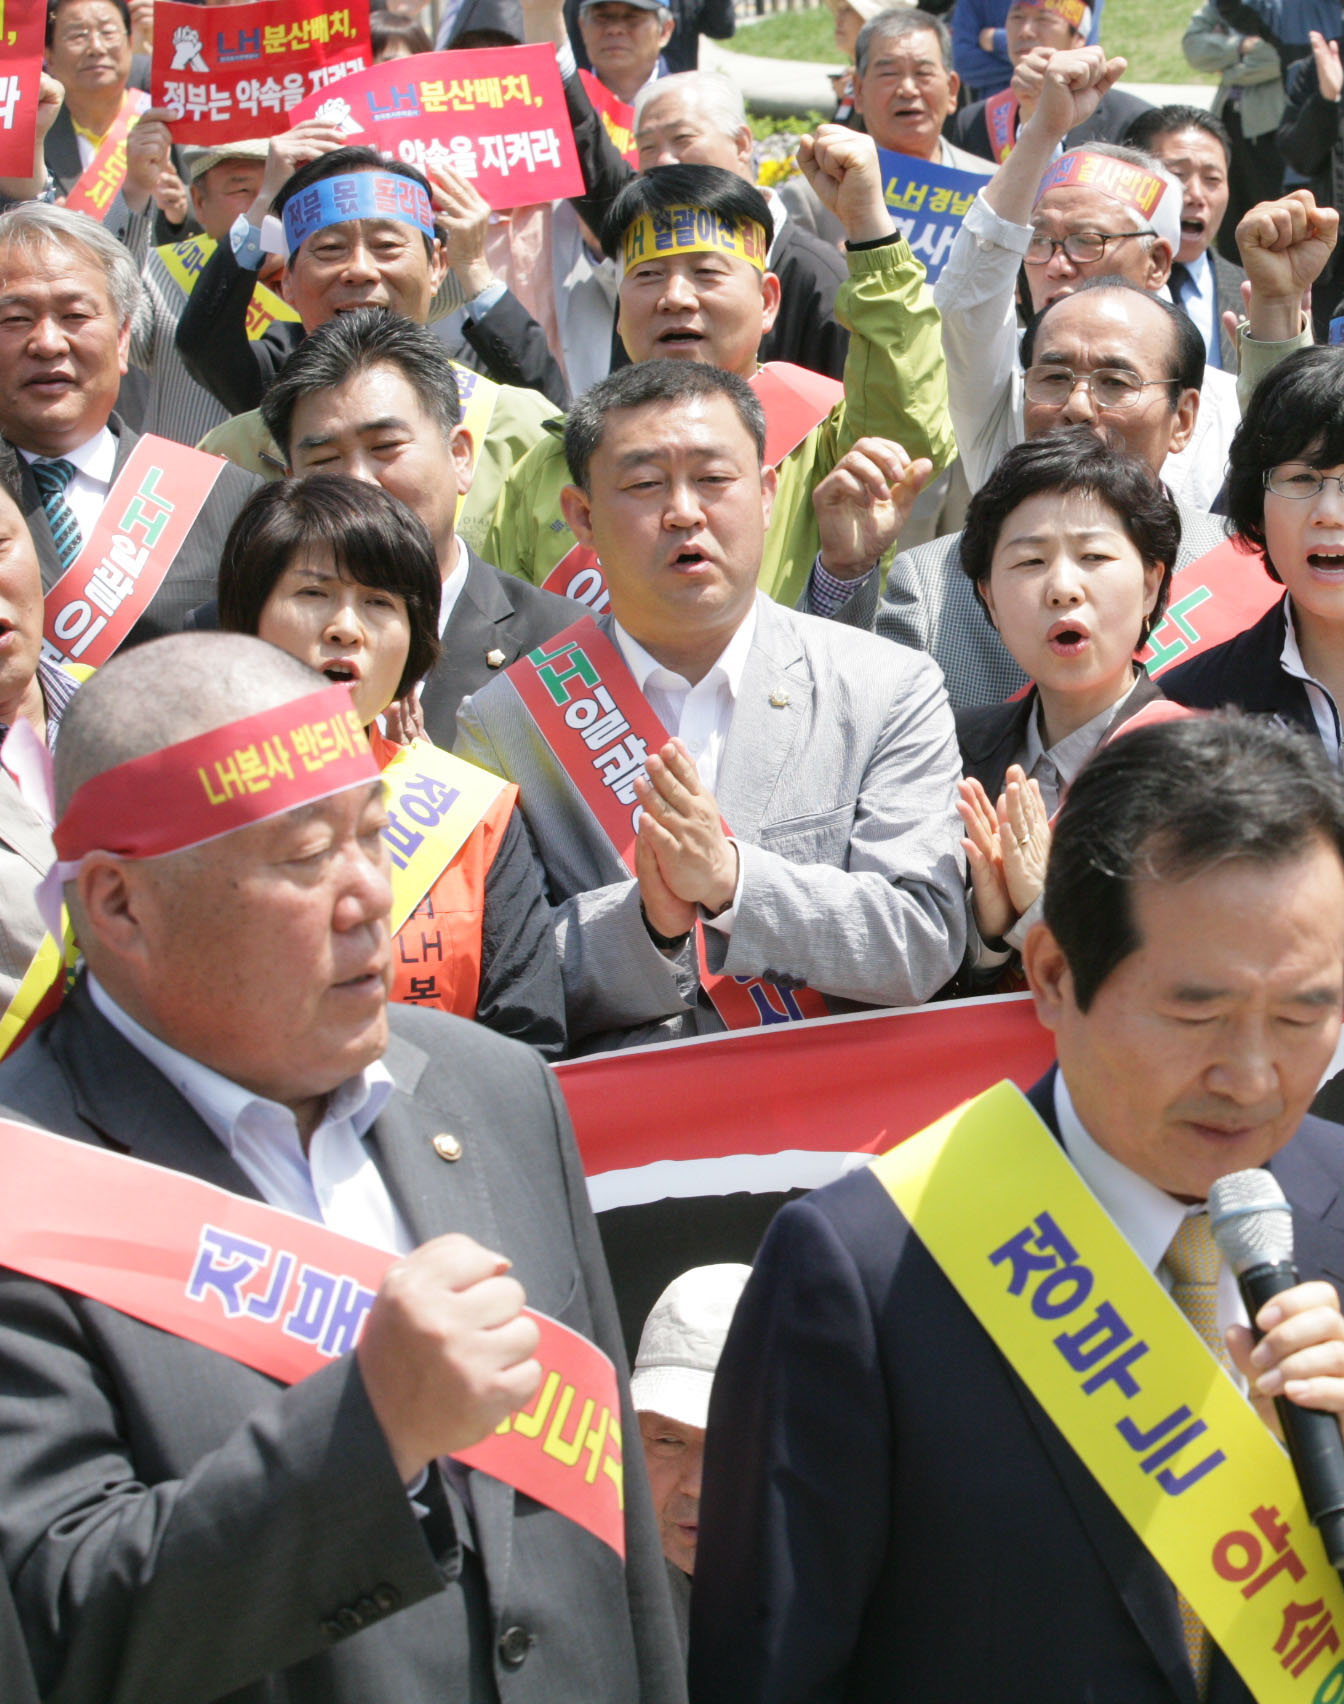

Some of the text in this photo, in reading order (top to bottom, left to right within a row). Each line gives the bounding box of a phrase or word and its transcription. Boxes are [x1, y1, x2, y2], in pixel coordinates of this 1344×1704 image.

[217, 9, 357, 54] LH 분산배치,
[162, 80, 232, 122] 정부는
[235, 73, 305, 117] 약속을
[366, 74, 543, 113] LH 분산배치,
[479, 127, 561, 176] 지켜라
[885, 177, 929, 204] LH
[987, 1210, 1227, 1498] 정부는
